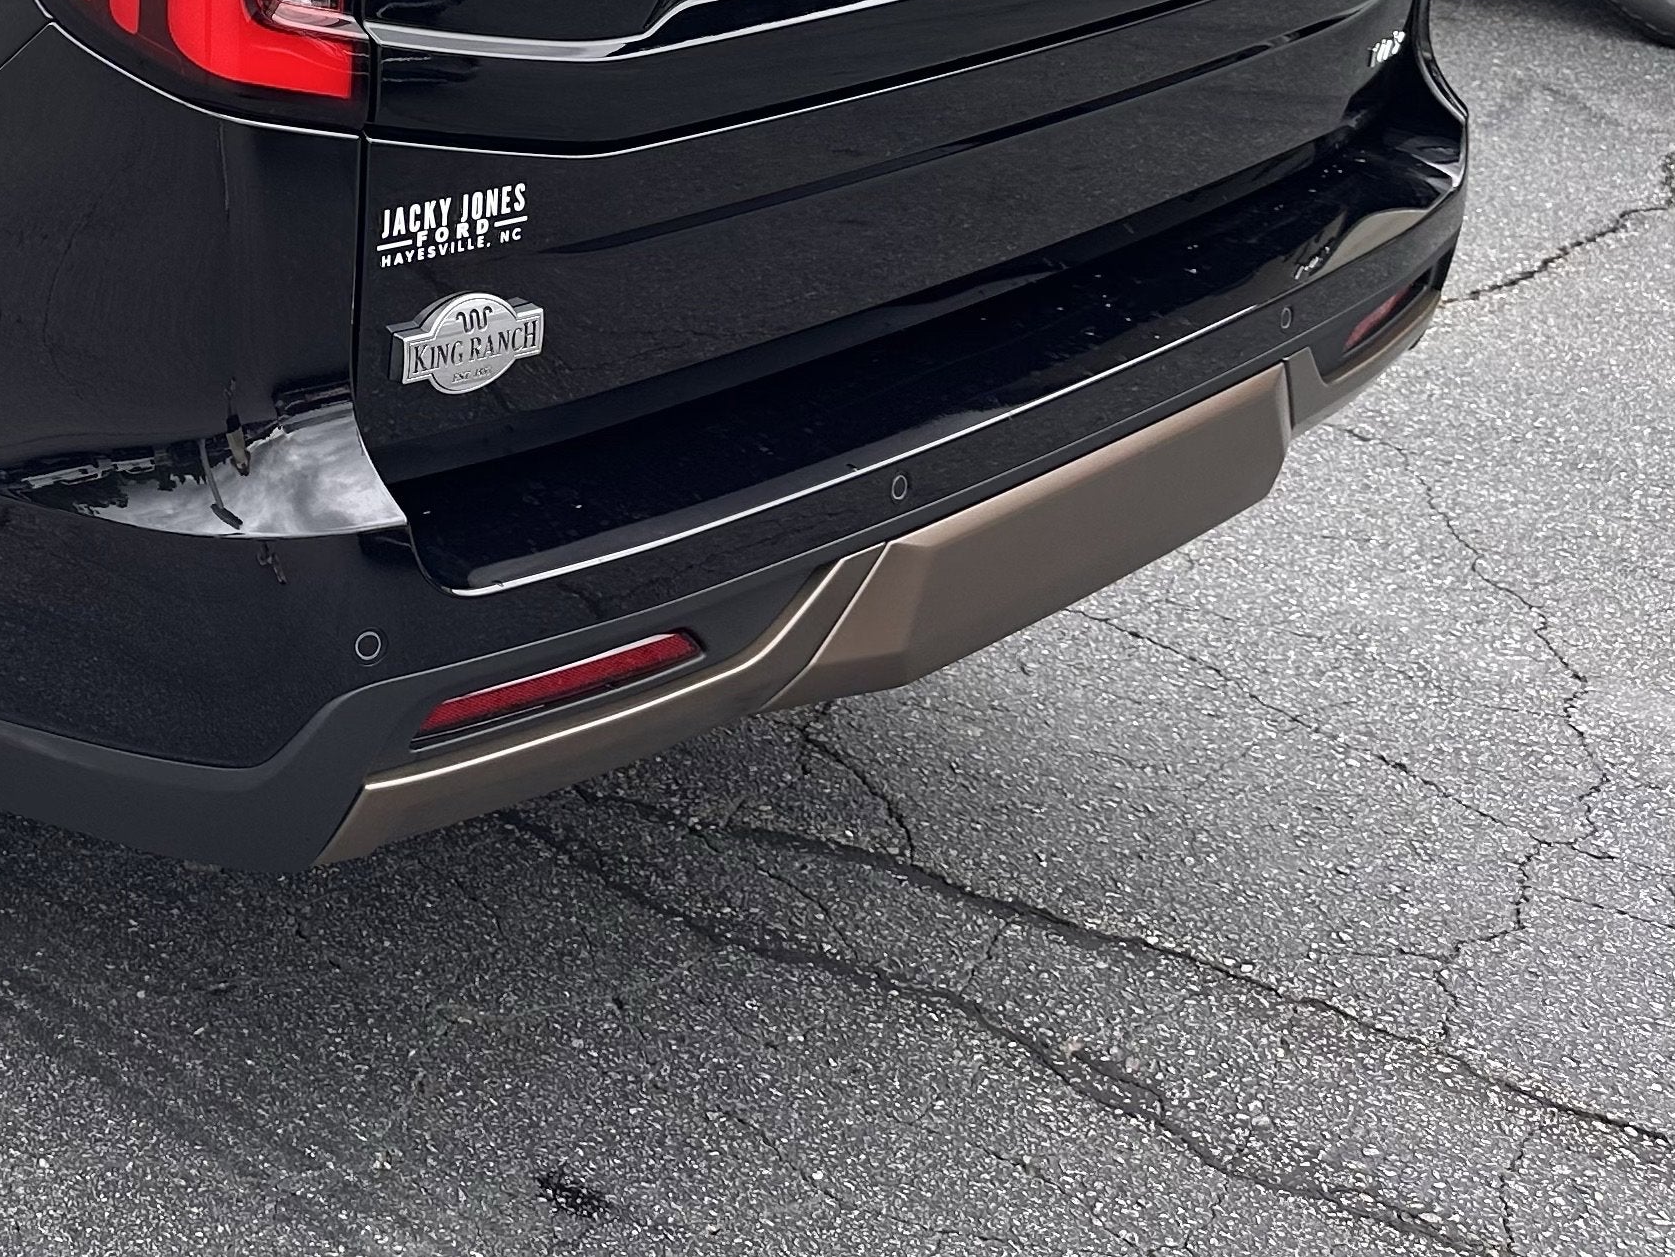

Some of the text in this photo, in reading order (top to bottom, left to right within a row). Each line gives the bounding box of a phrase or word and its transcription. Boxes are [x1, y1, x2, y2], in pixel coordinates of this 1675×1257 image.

[381, 182, 526, 239] JACKY JONES
[416, 218, 490, 248] FORD
[379, 227, 522, 268] HAYESVILLE, NC
[412, 319, 538, 375] KING RANCH
